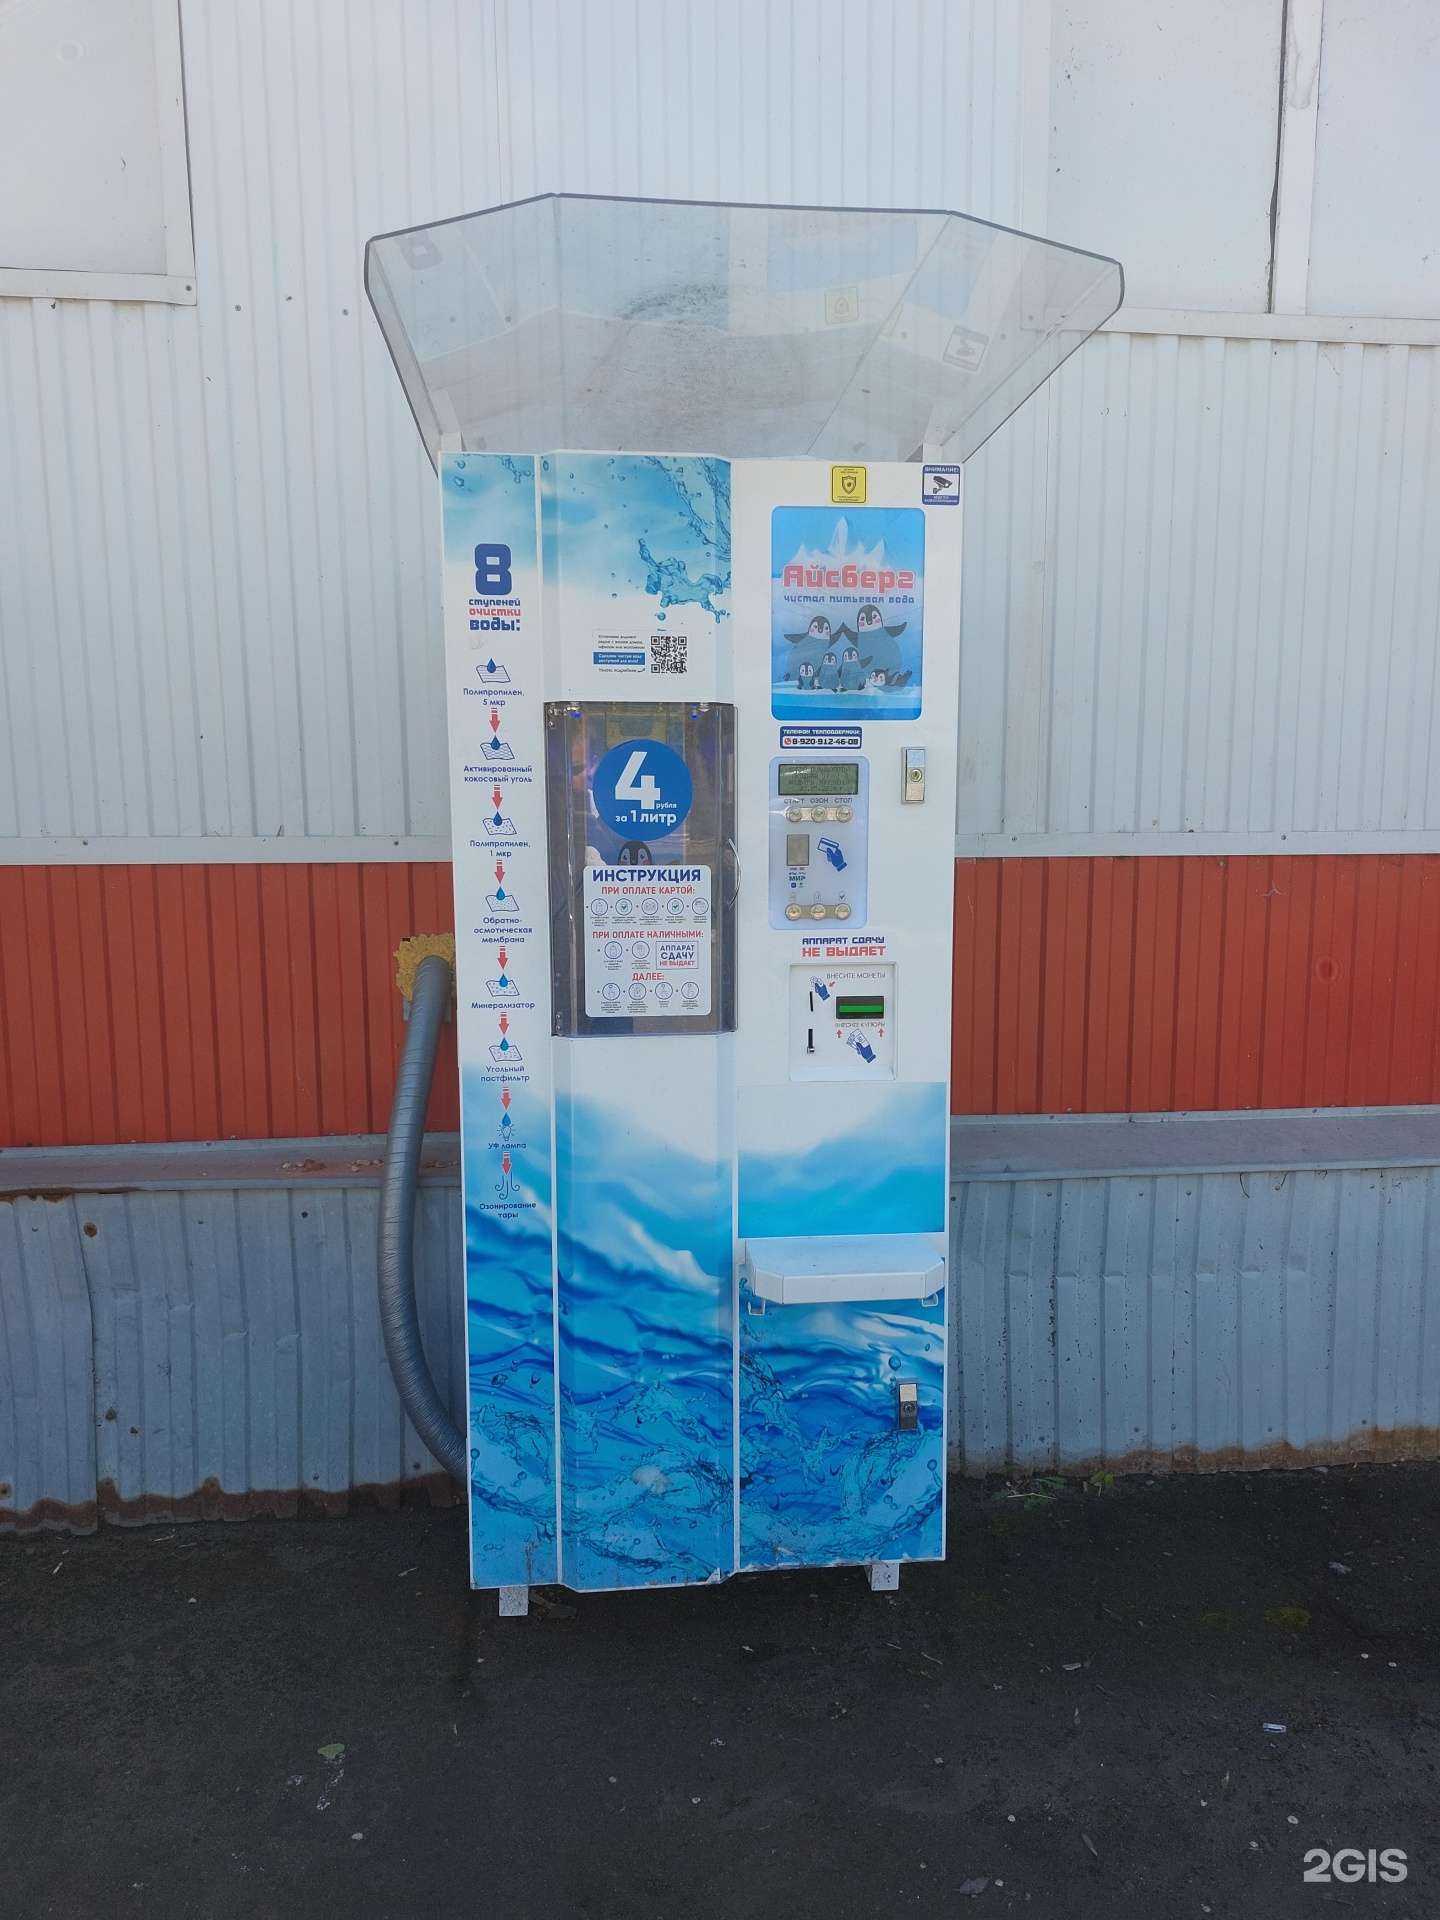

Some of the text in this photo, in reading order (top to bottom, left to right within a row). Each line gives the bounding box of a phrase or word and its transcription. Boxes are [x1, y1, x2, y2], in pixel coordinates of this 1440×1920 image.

[475, 544, 512, 595] 8
[784, 564, 915, 592] Айсберг
[469, 598, 520, 607] ступеней
[784, 594, 915, 604] чистая питьевая вода
[470, 617, 520, 631] воды:
[463, 688, 524, 697] Полипропилен,
[489, 700, 506, 708] мкр
[464, 766, 532, 775] Активированный
[615, 751, 660, 809] 4
[630, 810, 637, 822] 1
[640, 812, 677, 826] литр
[470, 840, 531, 849] Полипропилен,
[593, 869, 701, 883] ИНСТРУКЦИЯ
[602, 885, 696, 895] ПРИ ОПЛАТЕ КАРТОЙ:
[483, 916, 522, 925] Обратно-
[647, 930, 704, 938] НАЛИЧНЫМИ:
[481, 936, 524, 944] мембрана
[660, 952, 694, 960] СДАЧУ
[802, 946, 886, 957] НЕ ВЫДАЕТ
[632, 972, 664, 981] ДАЛЕЕ:
